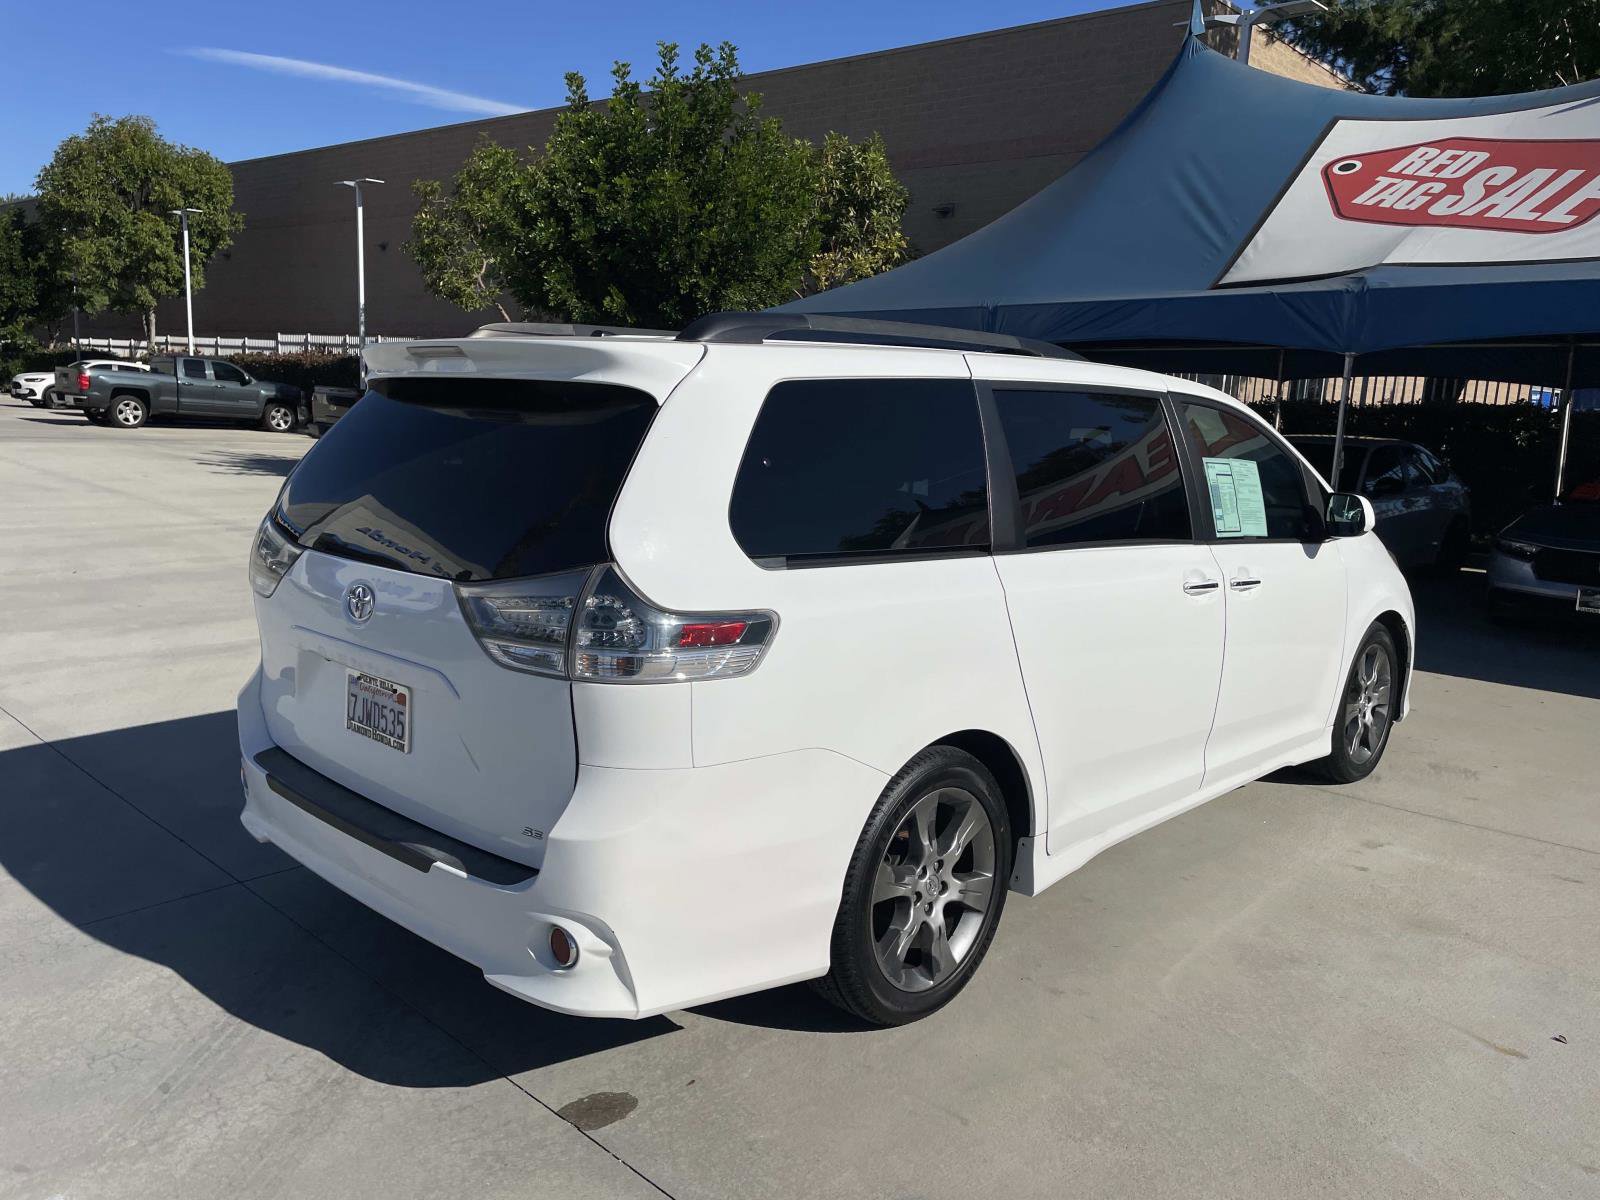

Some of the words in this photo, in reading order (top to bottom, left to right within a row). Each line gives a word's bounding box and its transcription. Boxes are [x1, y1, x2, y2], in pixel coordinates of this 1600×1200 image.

[1388, 146, 1490, 179] RED
[1351, 176, 1447, 211] TAG
[350, 692, 406, 741] 7JWD535
